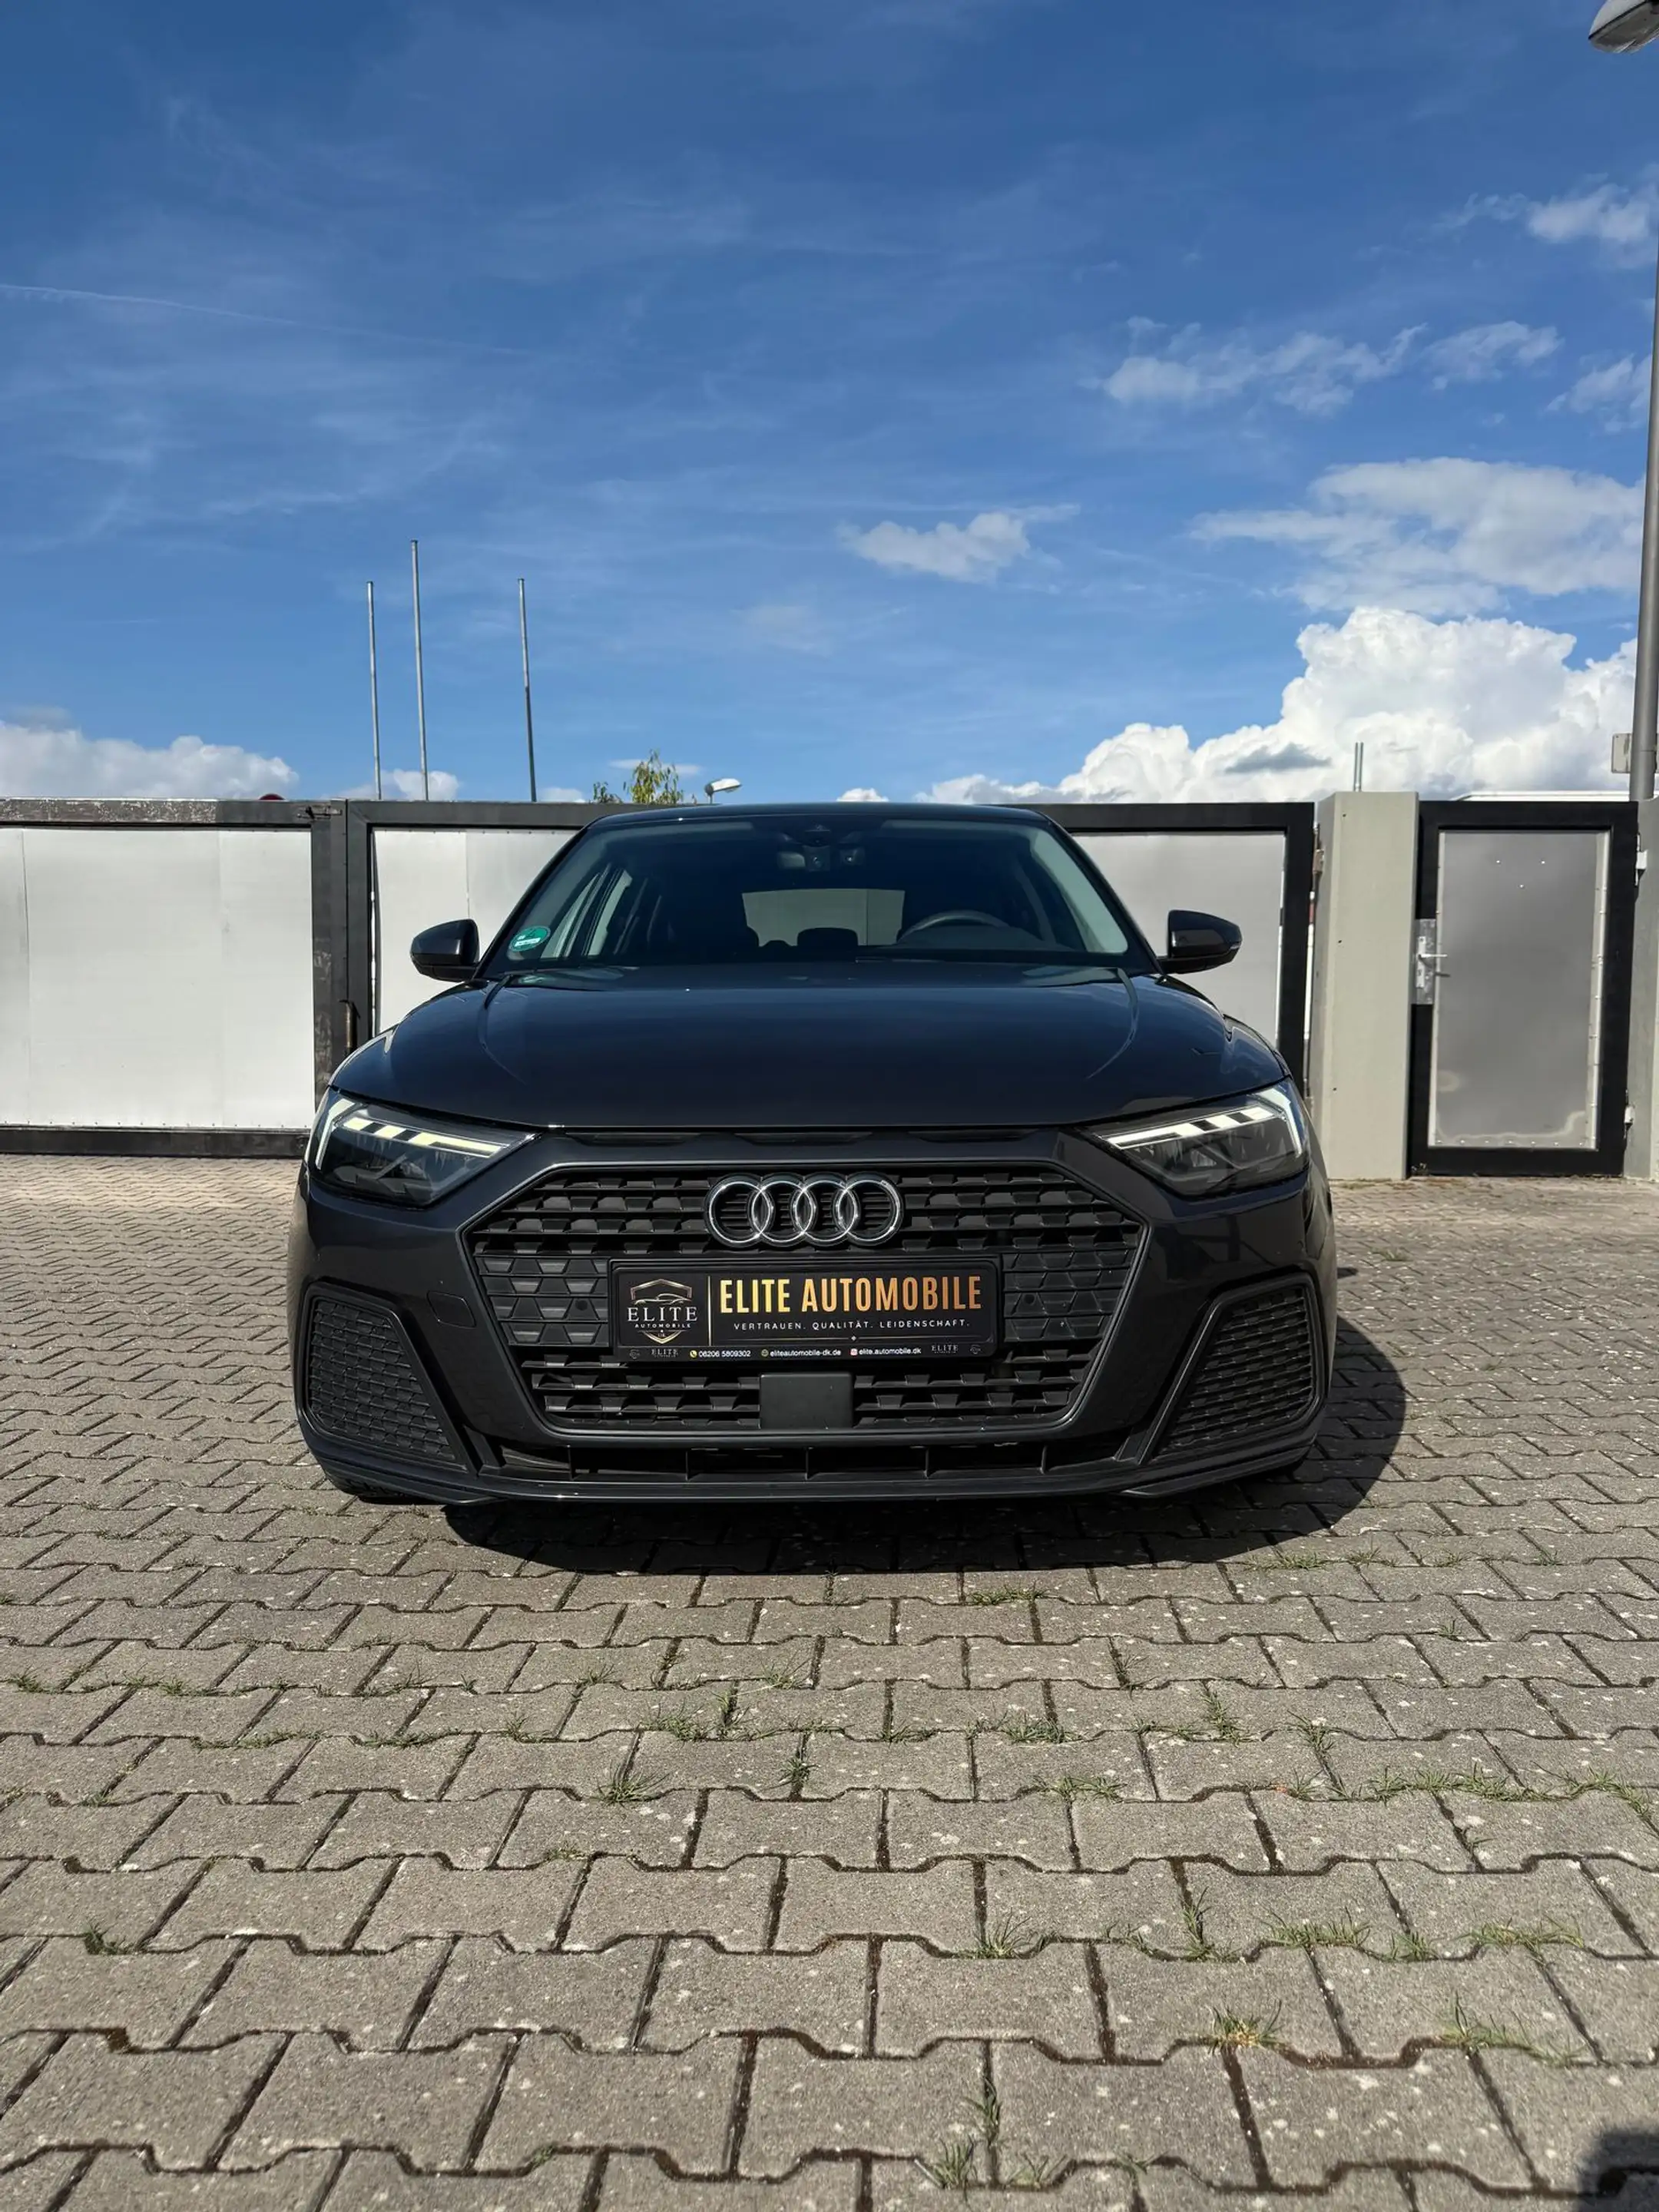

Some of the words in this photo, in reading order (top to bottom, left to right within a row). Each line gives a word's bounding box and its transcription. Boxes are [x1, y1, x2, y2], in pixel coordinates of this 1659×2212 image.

[720, 1278, 791, 1313] ELITE
[801, 1275, 982, 1313] AUTOMOBILE
[627, 1306, 698, 1322] ELITE
[733, 1321, 806, 1330] VERTRAUEN.
[812, 1319, 874, 1330] QUALITÄT.
[879, 1318, 970, 1330] LEIDENSCHAFT.
[770, 1348, 842, 1357] eliteautomobile-dk.de
[858, 1346, 922, 1356] elite.automobile.dk
